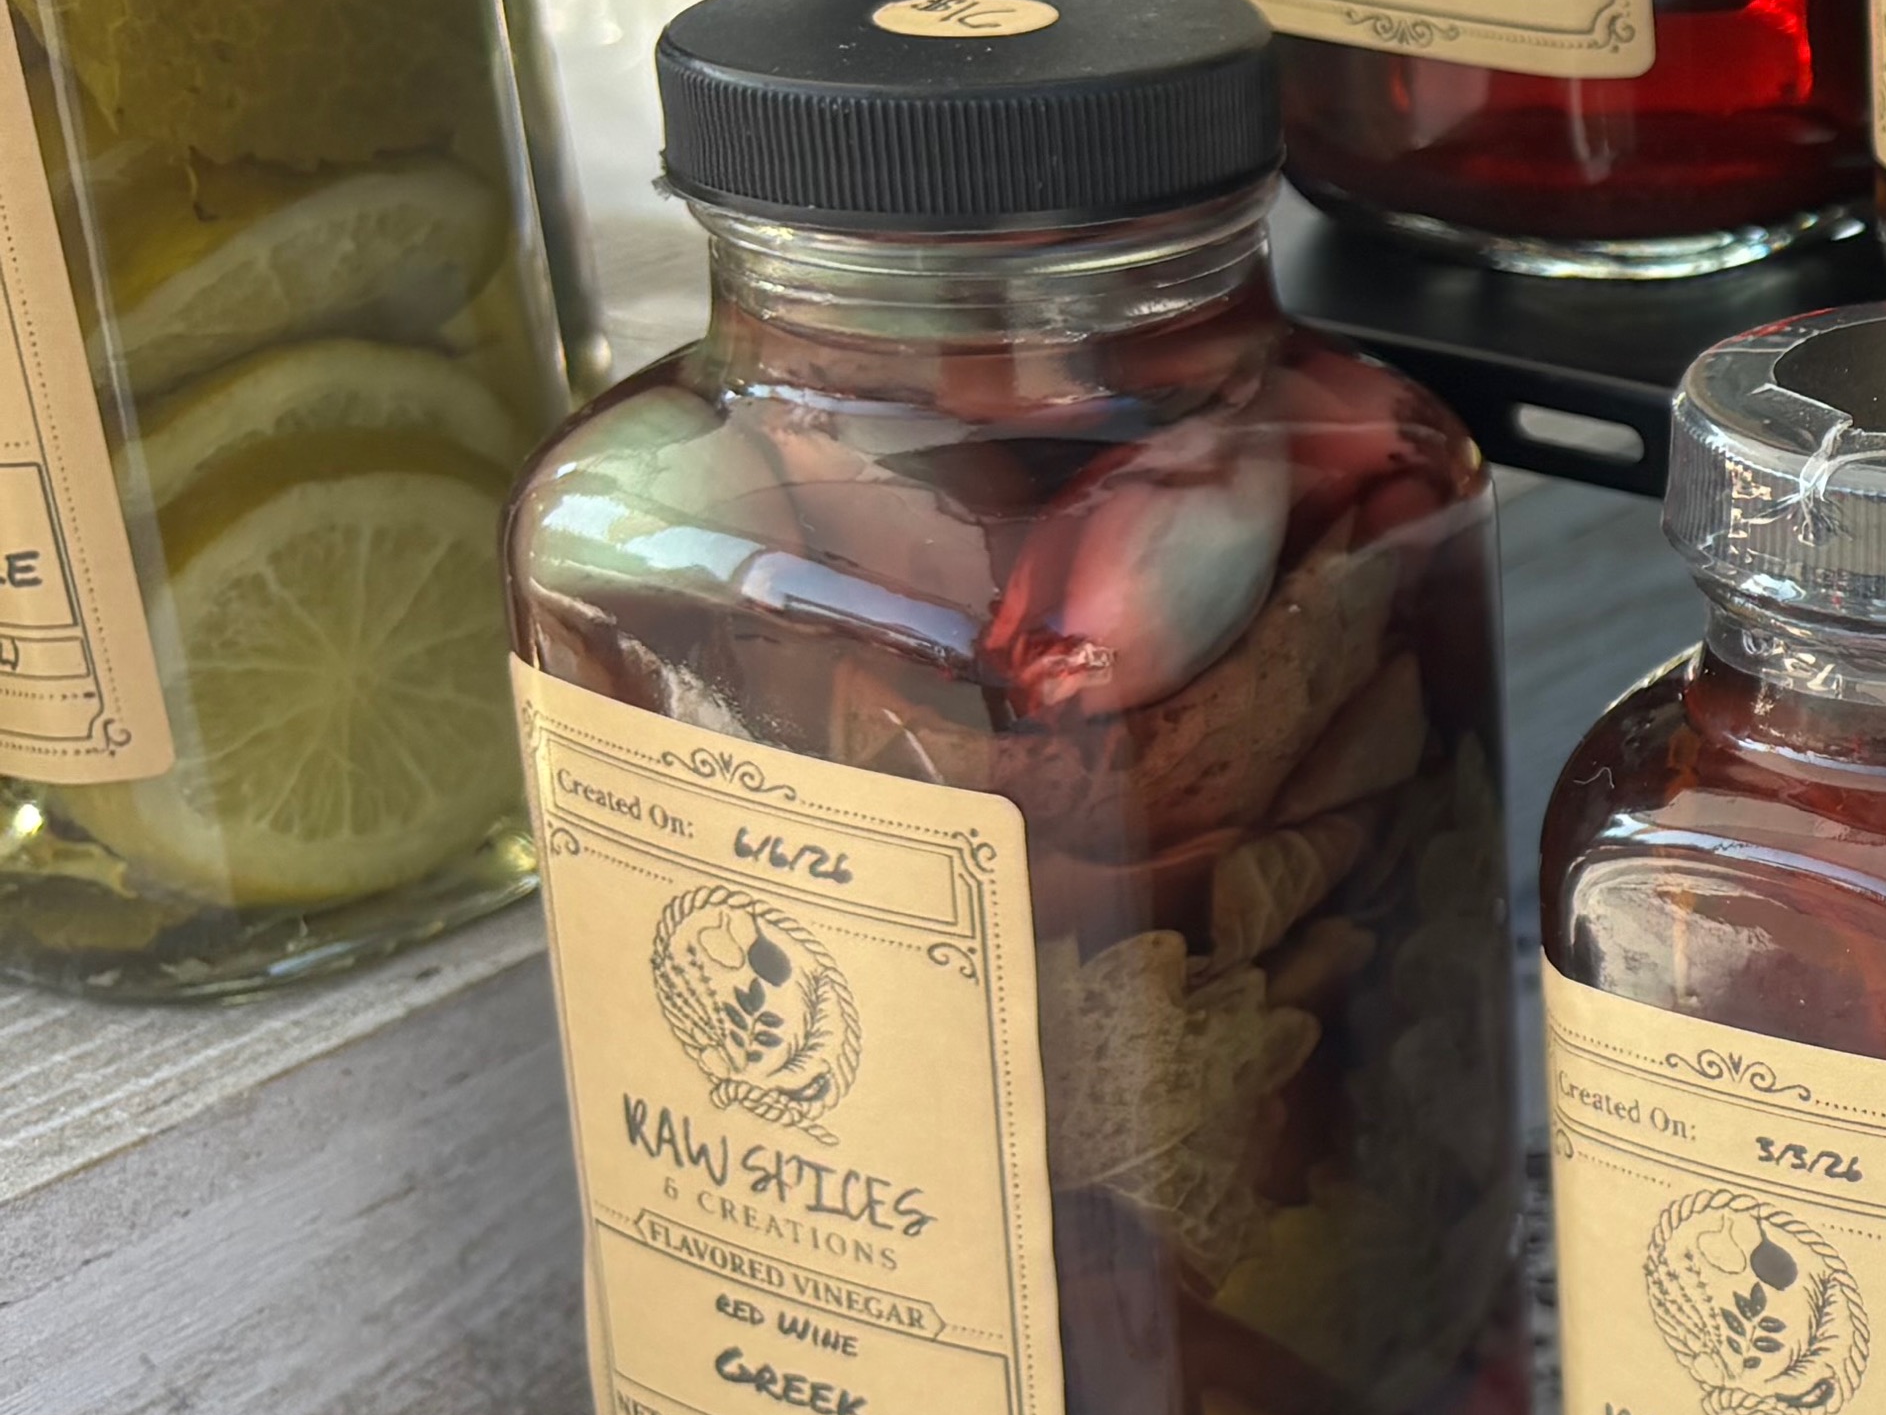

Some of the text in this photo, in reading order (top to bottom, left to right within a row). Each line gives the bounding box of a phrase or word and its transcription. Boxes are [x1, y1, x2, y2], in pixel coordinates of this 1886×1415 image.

[557, 768, 854, 885] Created On: 6/6/26
[623, 1093, 938, 1237] RAW SPICES
[1559, 1070, 1863, 1183] Created On: 3/3/26
[648, 1219, 926, 1332] FLAVORED VINEGAR
[697, 1190, 899, 1273] CREATIONS
[715, 1292, 859, 1357] RED WINE
